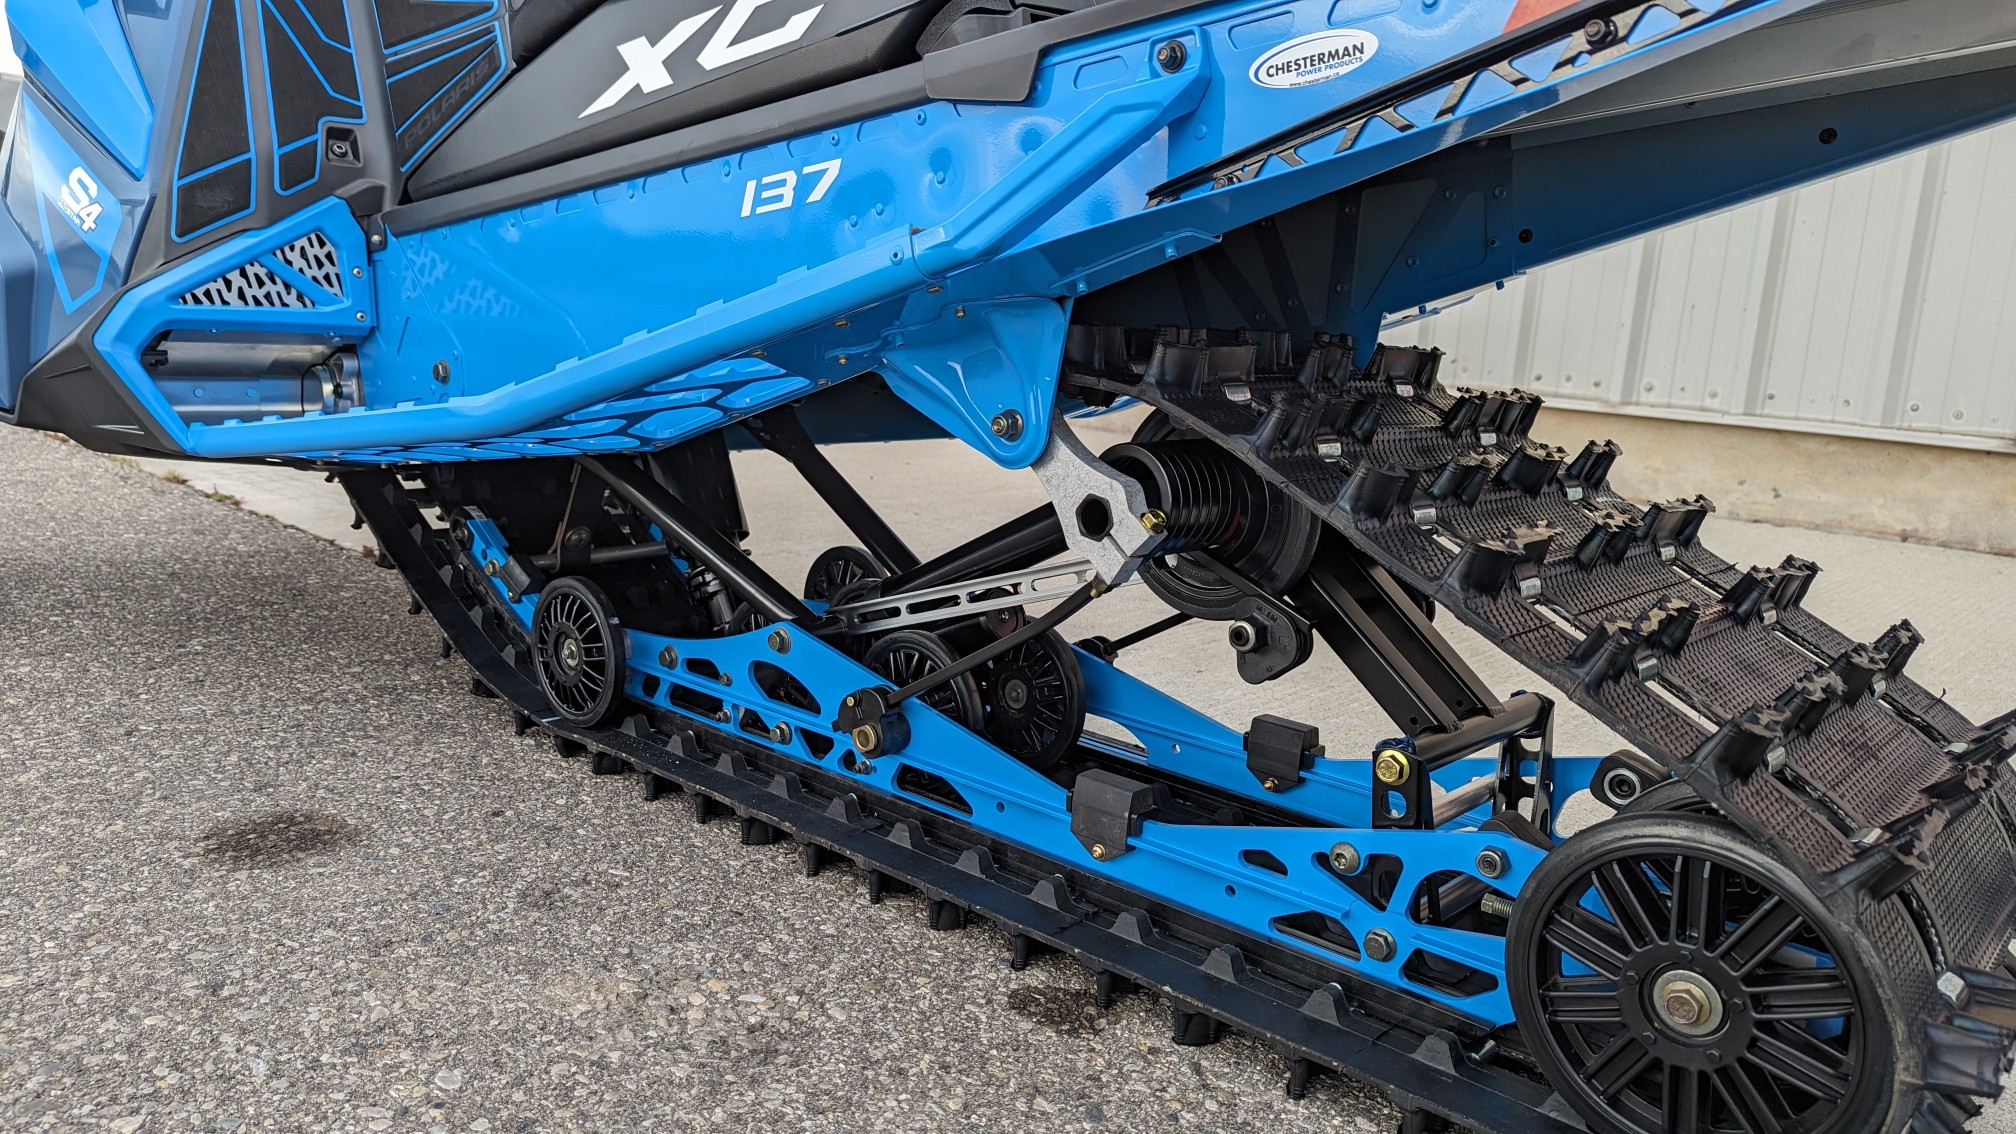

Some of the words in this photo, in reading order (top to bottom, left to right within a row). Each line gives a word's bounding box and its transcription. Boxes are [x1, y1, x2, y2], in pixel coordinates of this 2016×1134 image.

[577, 0, 824, 119] XC
[1266, 42, 1365, 78] CHESTERMAN
[1296, 66, 1322, 78] POWER
[1324, 56, 1363, 70] PRODUCTS
[404, 57, 490, 149] POLARIS
[60, 166, 103, 232] S4
[740, 158, 842, 217] 137
